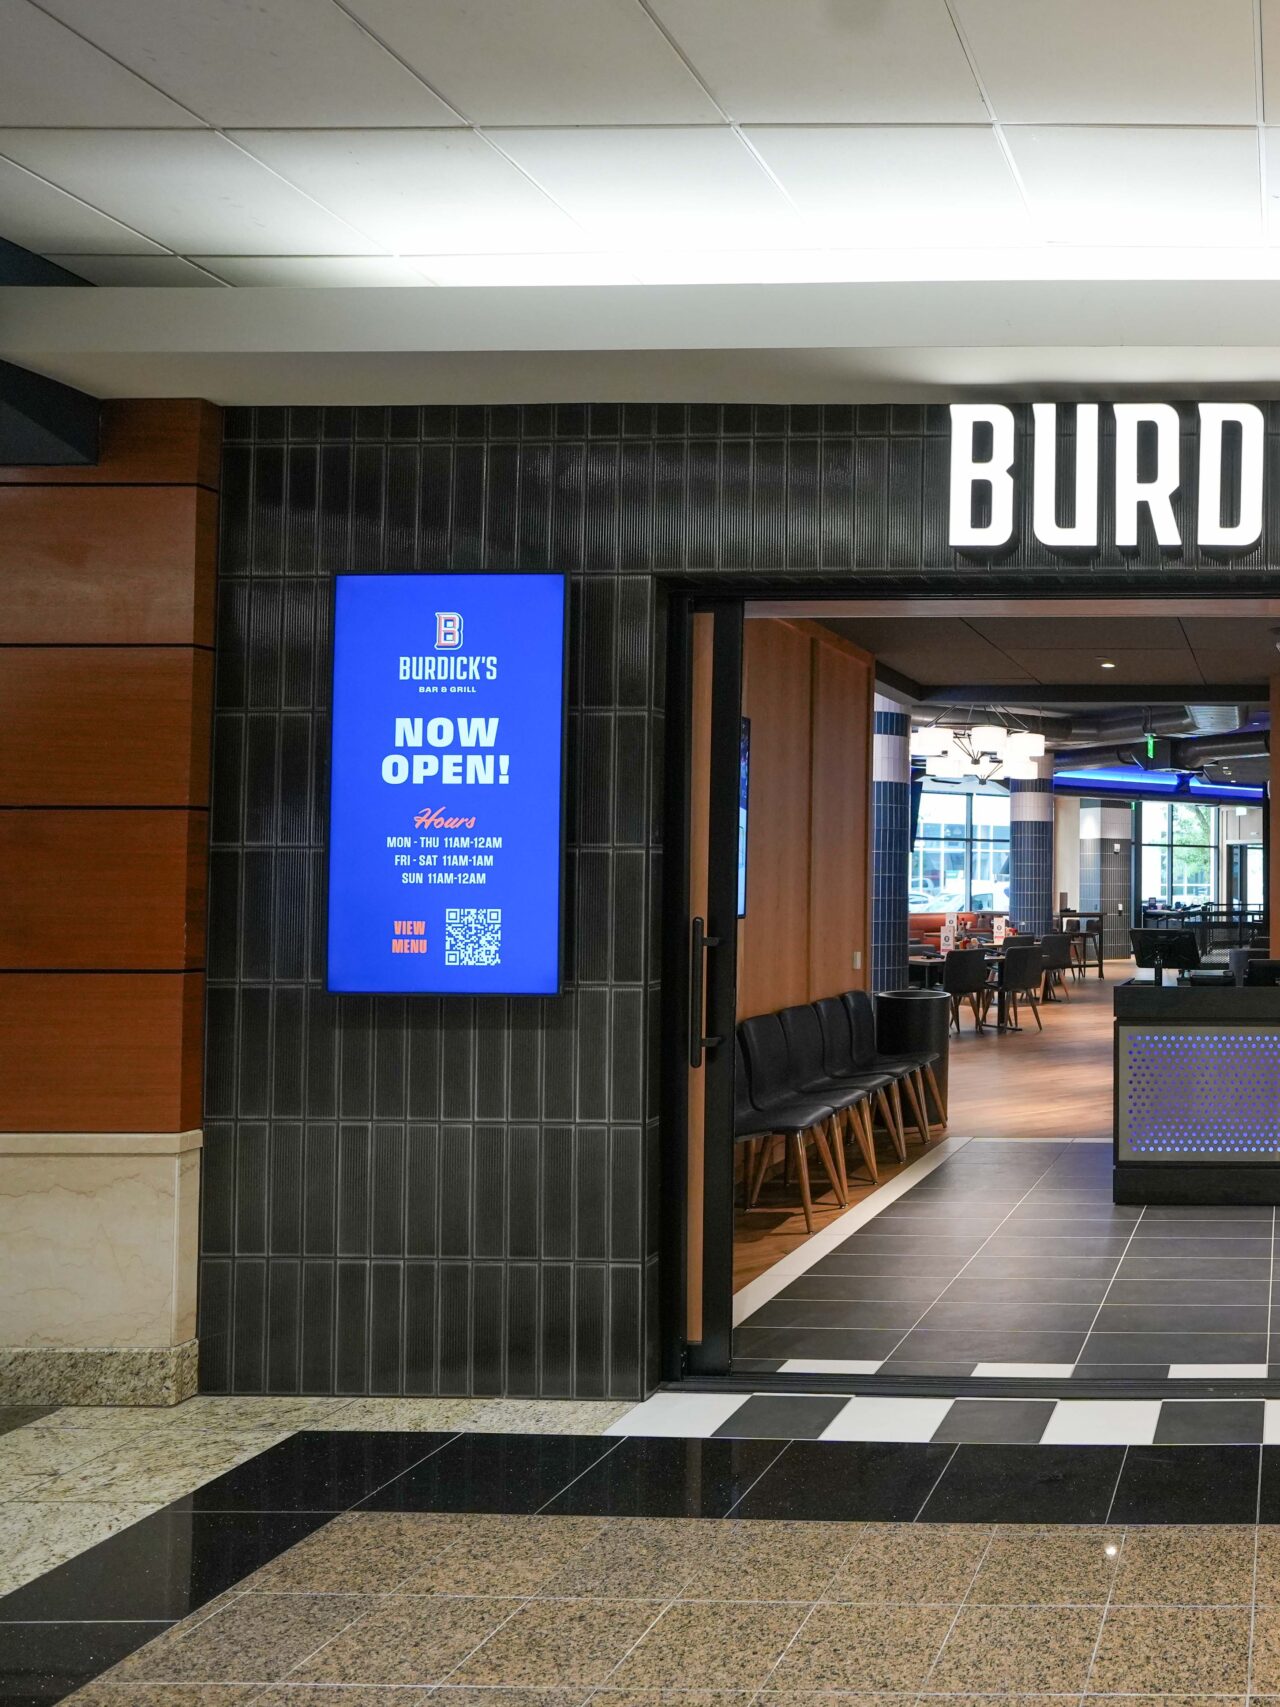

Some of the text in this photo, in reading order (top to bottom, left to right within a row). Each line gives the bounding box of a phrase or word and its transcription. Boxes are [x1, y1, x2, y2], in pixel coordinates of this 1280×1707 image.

[434, 612, 464, 650] B
[399, 656, 498, 681] BURDICK'S
[394, 717, 500, 748] NOW
[381, 754, 510, 784] OPEN!
[413, 806, 477, 830] Hours
[386, 836, 412, 848] MON
[419, 836, 440, 848] THU
[443, 836, 503, 849] 11AM-12AM
[394, 854, 411, 866] FRI
[418, 854, 438, 866] SAT
[442, 854, 494, 867] 11AM-1AM
[401, 872, 486, 885] SUN 11AM-12AM
[393, 920, 426, 936] VIEW
[391, 938, 428, 954] MENU
